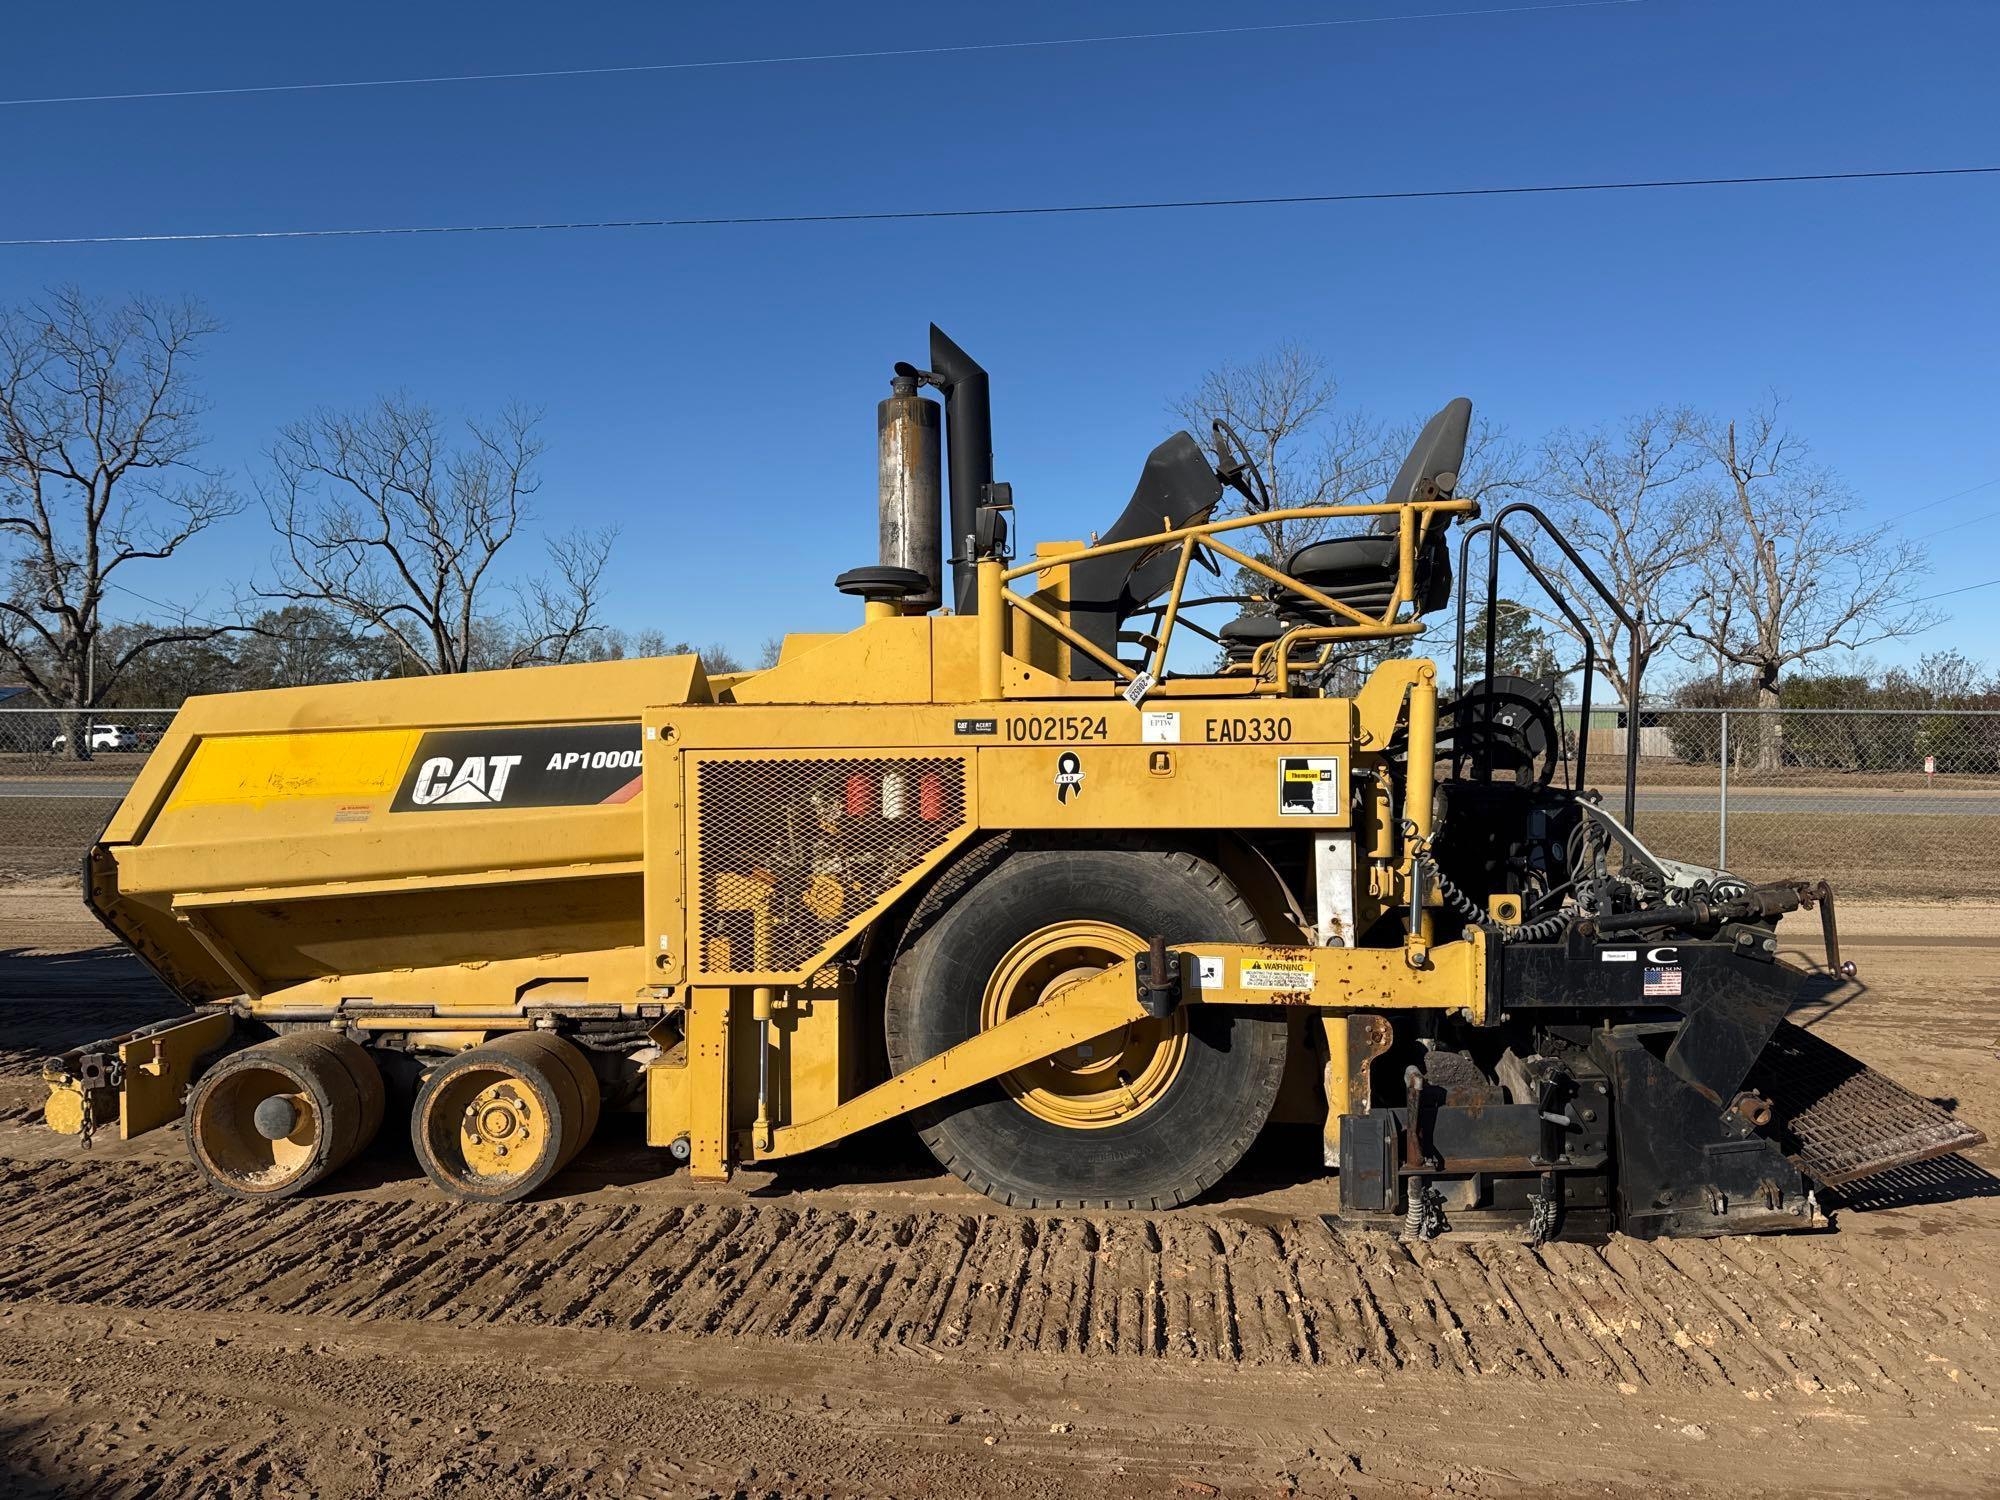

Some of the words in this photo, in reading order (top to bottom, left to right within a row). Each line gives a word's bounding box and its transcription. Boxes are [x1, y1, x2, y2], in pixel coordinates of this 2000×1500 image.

[1005, 717, 1107, 741] 10021524
[1206, 717, 1292, 742] EAD330
[412, 755, 522, 805] CAT
[1264, 963, 1304, 971] WARNING
